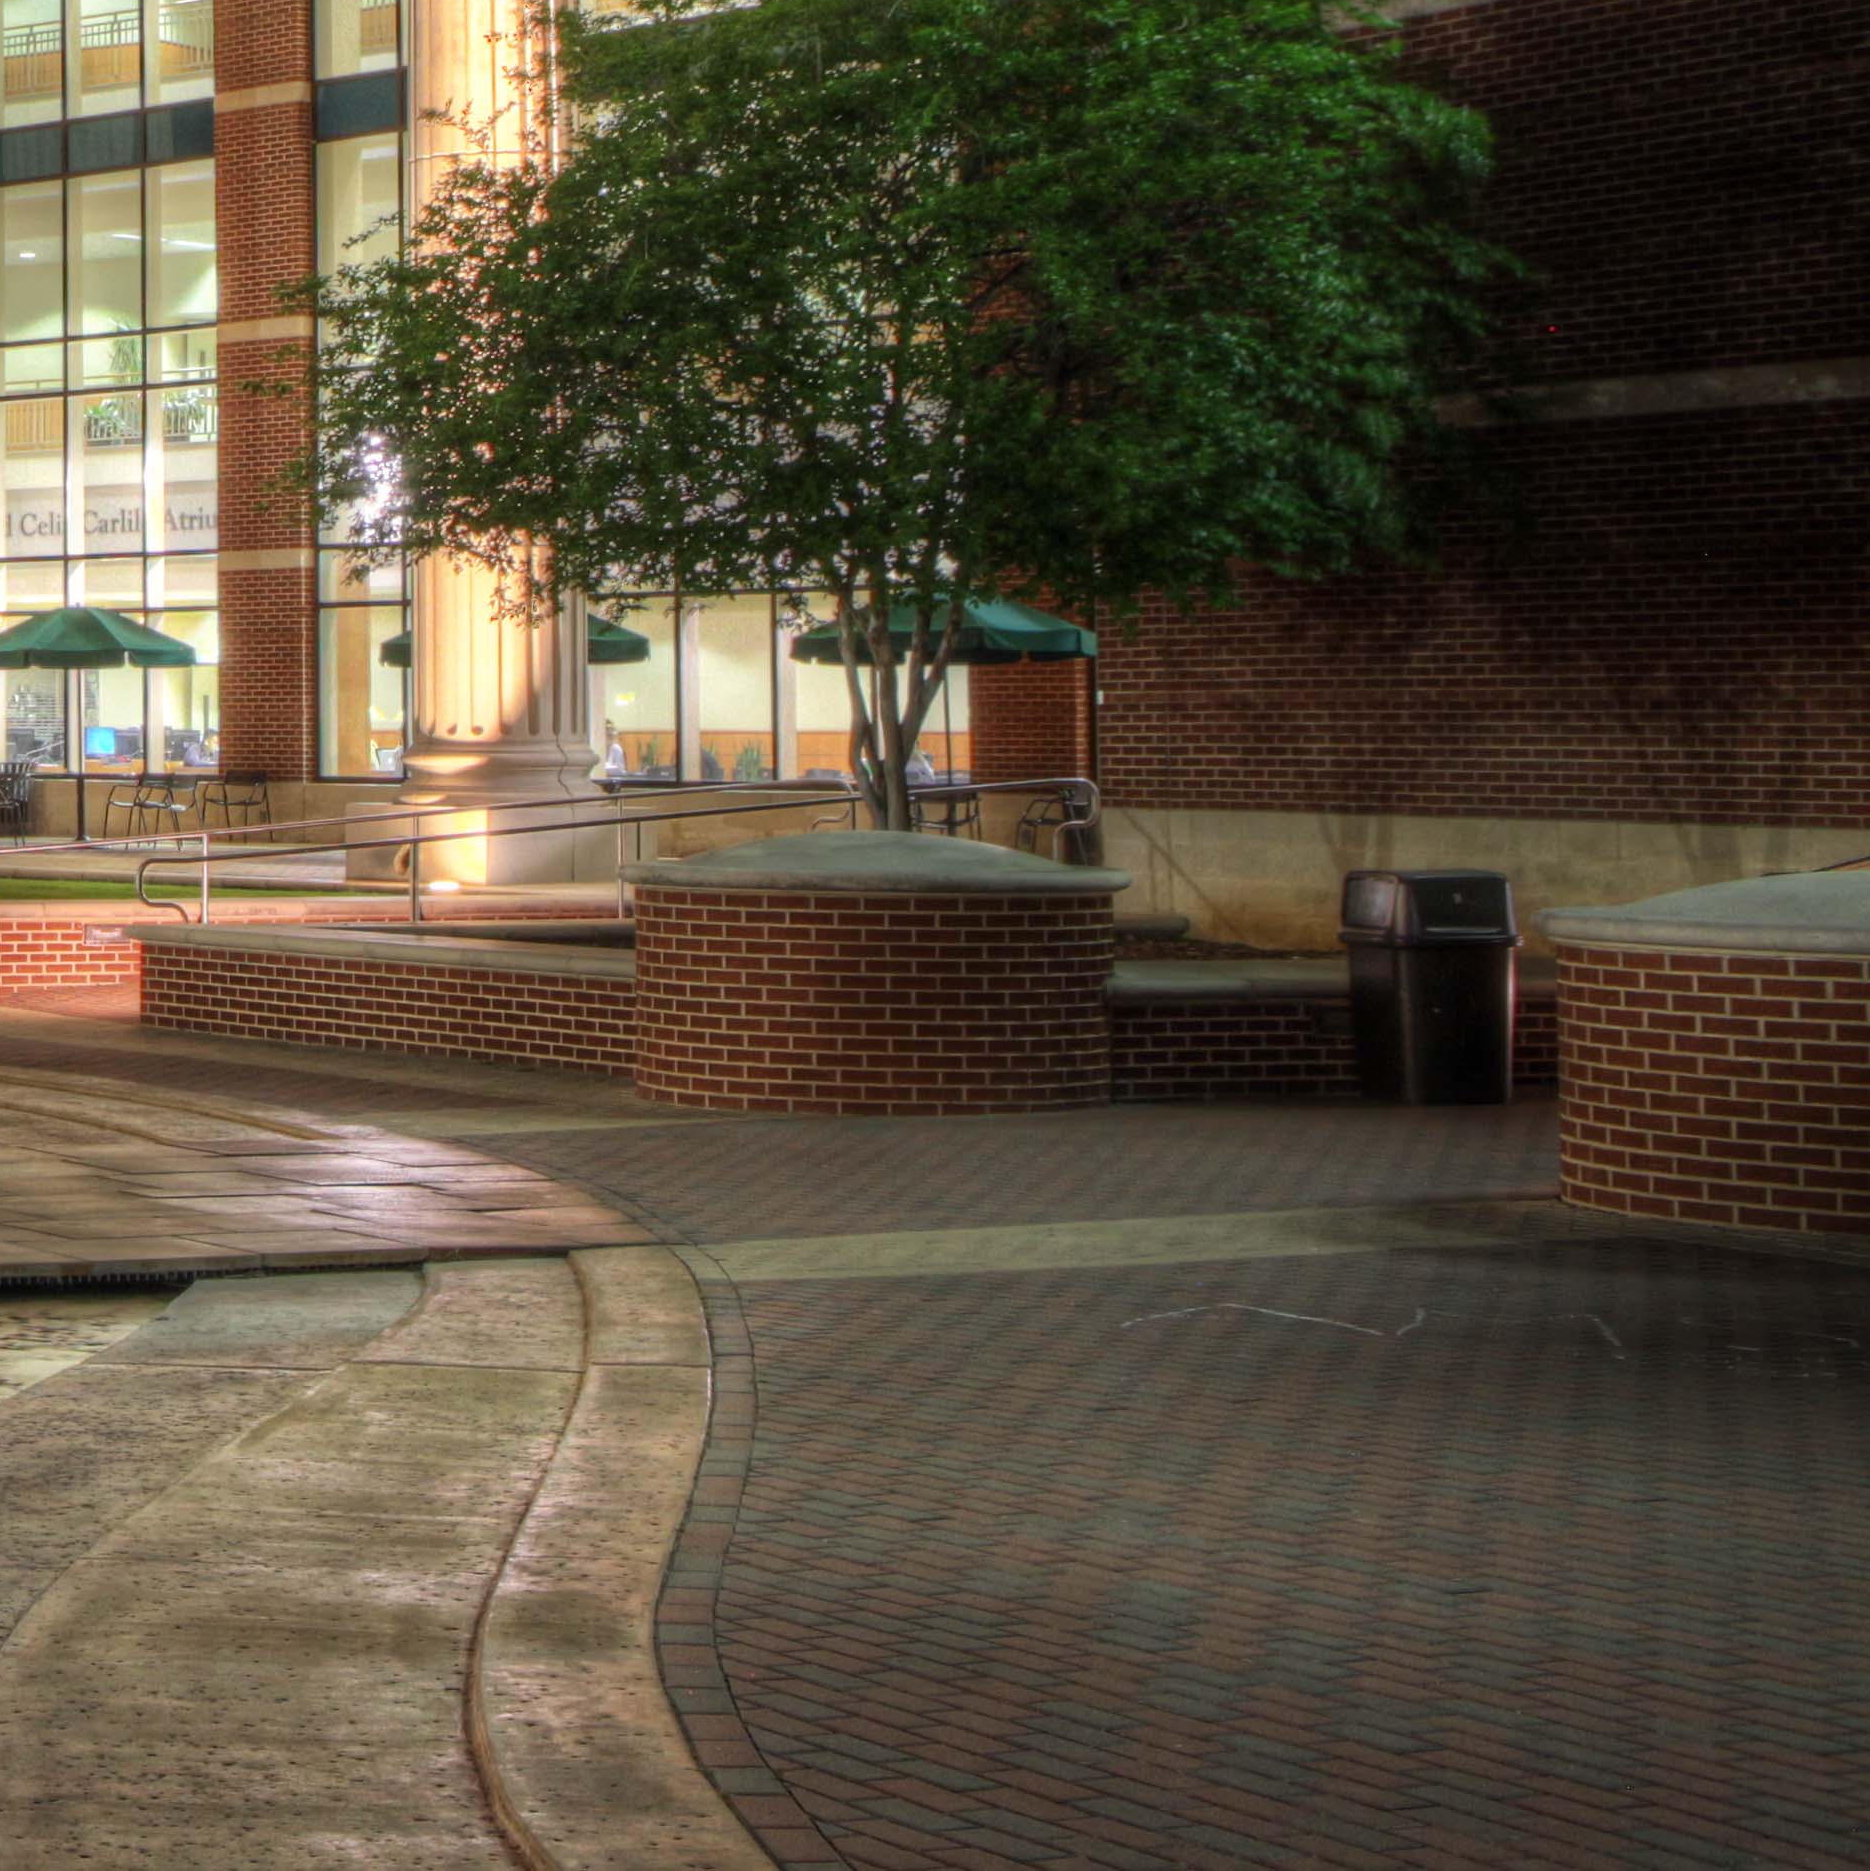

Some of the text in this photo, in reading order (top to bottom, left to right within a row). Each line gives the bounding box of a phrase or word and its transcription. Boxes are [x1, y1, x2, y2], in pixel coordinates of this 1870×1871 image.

[20, 511, 64, 538] Celi
[83, 506, 143, 536] Carlil
[163, 505, 218, 532] Atriu
